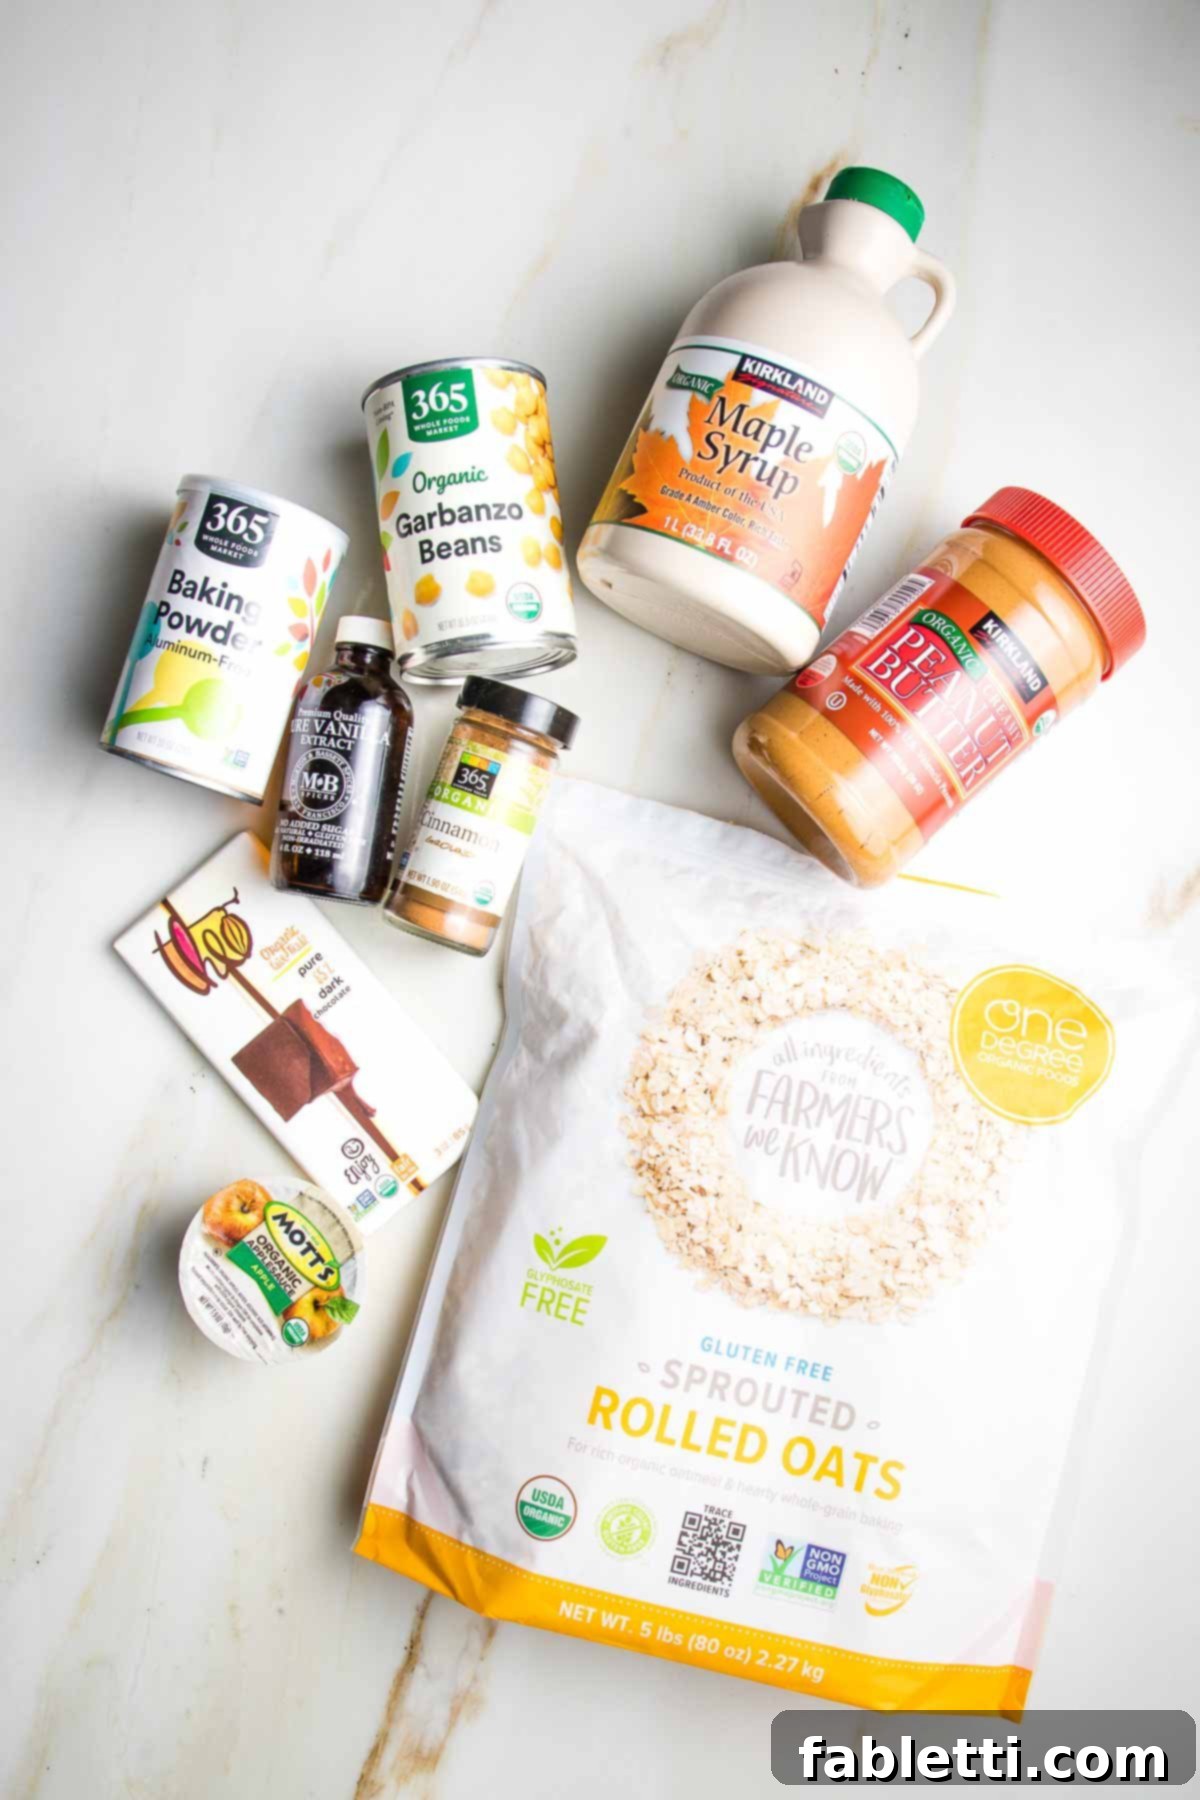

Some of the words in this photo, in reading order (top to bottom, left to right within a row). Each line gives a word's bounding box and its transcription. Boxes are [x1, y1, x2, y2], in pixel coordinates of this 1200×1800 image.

[670, 371, 714, 394] ORGANIC
[742, 357, 830, 406] KIRKLAND
[411, 382, 468, 421] 365
[413, 420, 440, 433] WHOLE
[442, 415, 471, 428] FOODS
[426, 424, 459, 437] MARKET
[704, 396, 814, 464] Maple
[412, 465, 488, 495] Organic
[697, 430, 799, 499] Syrup
[660, 484, 685, 502] Grade
[684, 491, 693, 504] A
[692, 494, 721, 516] Amber
[722, 507, 746, 527] Color,
[678, 467, 721, 491] Product
[724, 484, 737, 497] of
[738, 490, 759, 508] the
[206, 501, 270, 545] 365
[395, 501, 523, 539] Garbanzo
[671, 518, 681, 533] L
[716, 534, 735, 555] FL
[202, 533, 230, 548] WHOLE
[230, 541, 260, 558] FOODS
[209, 543, 245, 561] MARKET
[418, 534, 503, 564] Beans
[167, 569, 262, 626] Baking
[153, 600, 263, 655] Powder
[921, 611, 981, 674] ORGANIC
[981, 618, 1042, 692] KIRKLAND
[841, 675, 864, 697] Made
[862, 691, 883, 714] with
[881, 710, 902, 734] 100%
[890, 627, 1013, 765] PEANUT
[290, 718, 311, 734] URE
[313, 719, 391, 747] VANILA
[298, 708, 332, 720] Premium
[333, 709, 367, 724] Qualit
[867, 648, 987, 787] BUTTER
[300, 734, 355, 751] EXTRACT
[457, 766, 489, 793] 365
[433, 785, 488, 812] ORGAN
[289, 820, 321, 832] ADDED
[321, 823, 352, 835] SUGA
[420, 808, 501, 852] Cinnamon
[314, 848, 331, 859] 118
[298, 951, 324, 978] pure
[313, 985, 352, 1021] chocolate
[318, 975, 345, 1001] dark
[983, 999, 1088, 1050] one
[772, 1036, 799, 1068] all
[803, 1039, 913, 1100] ingredients
[820, 1070, 858, 1087] FROM
[976, 1051, 1035, 1077] ORGANIC
[745, 1069, 915, 1157] FARMERS
[744, 1123, 780, 1157] we
[778, 1131, 894, 1203] KNOW
[247, 1239, 296, 1297] APPLESAUCE
[251, 1263, 276, 1292] APPLE
[256, 1234, 302, 1289] ORGANIC
[525, 1267, 593, 1296] GLYPHOSATE
[519, 1281, 592, 1327] FREE
[699, 1335, 779, 1370] GLUTEN
[783, 1355, 834, 1383] FREE
[659, 1358, 857, 1433] SPROUTED
[586, 1384, 769, 1466] ROLLED
[781, 1435, 907, 1502] OATS
[567, 1436, 589, 1455] For
[590, 1441, 616, 1461] rich
[617, 1450, 666, 1476] organic
[668, 1462, 723, 1488] oatmeal
[723, 1476, 735, 1491] &
[737, 1479, 778, 1505] hearty
[780, 1489, 858, 1525] whole-grain
[522, 1504, 567, 1530] ORGANIC
[530, 1487, 565, 1512] USDA
[703, 1504, 734, 1520] TRACE
[805, 1557, 842, 1577] GMO
[808, 1546, 844, 1566] NON
[667, 1574, 732, 1599] INGREDIENTS
[760, 1571, 837, 1600] VERIFIED
[802, 1567, 839, 1588] Project
[869, 1570, 901, 1590] NON
[558, 1600, 598, 1627] NET
[600, 1610, 634, 1637] WT.
[640, 1621, 653, 1640] 5
[657, 1624, 685, 1647] lbs
[688, 1631, 720, 1656] (80
[723, 1642, 752, 1667] oz)
[755, 1649, 800, 1674] 2.27
[801, 1659, 826, 1684] kg
